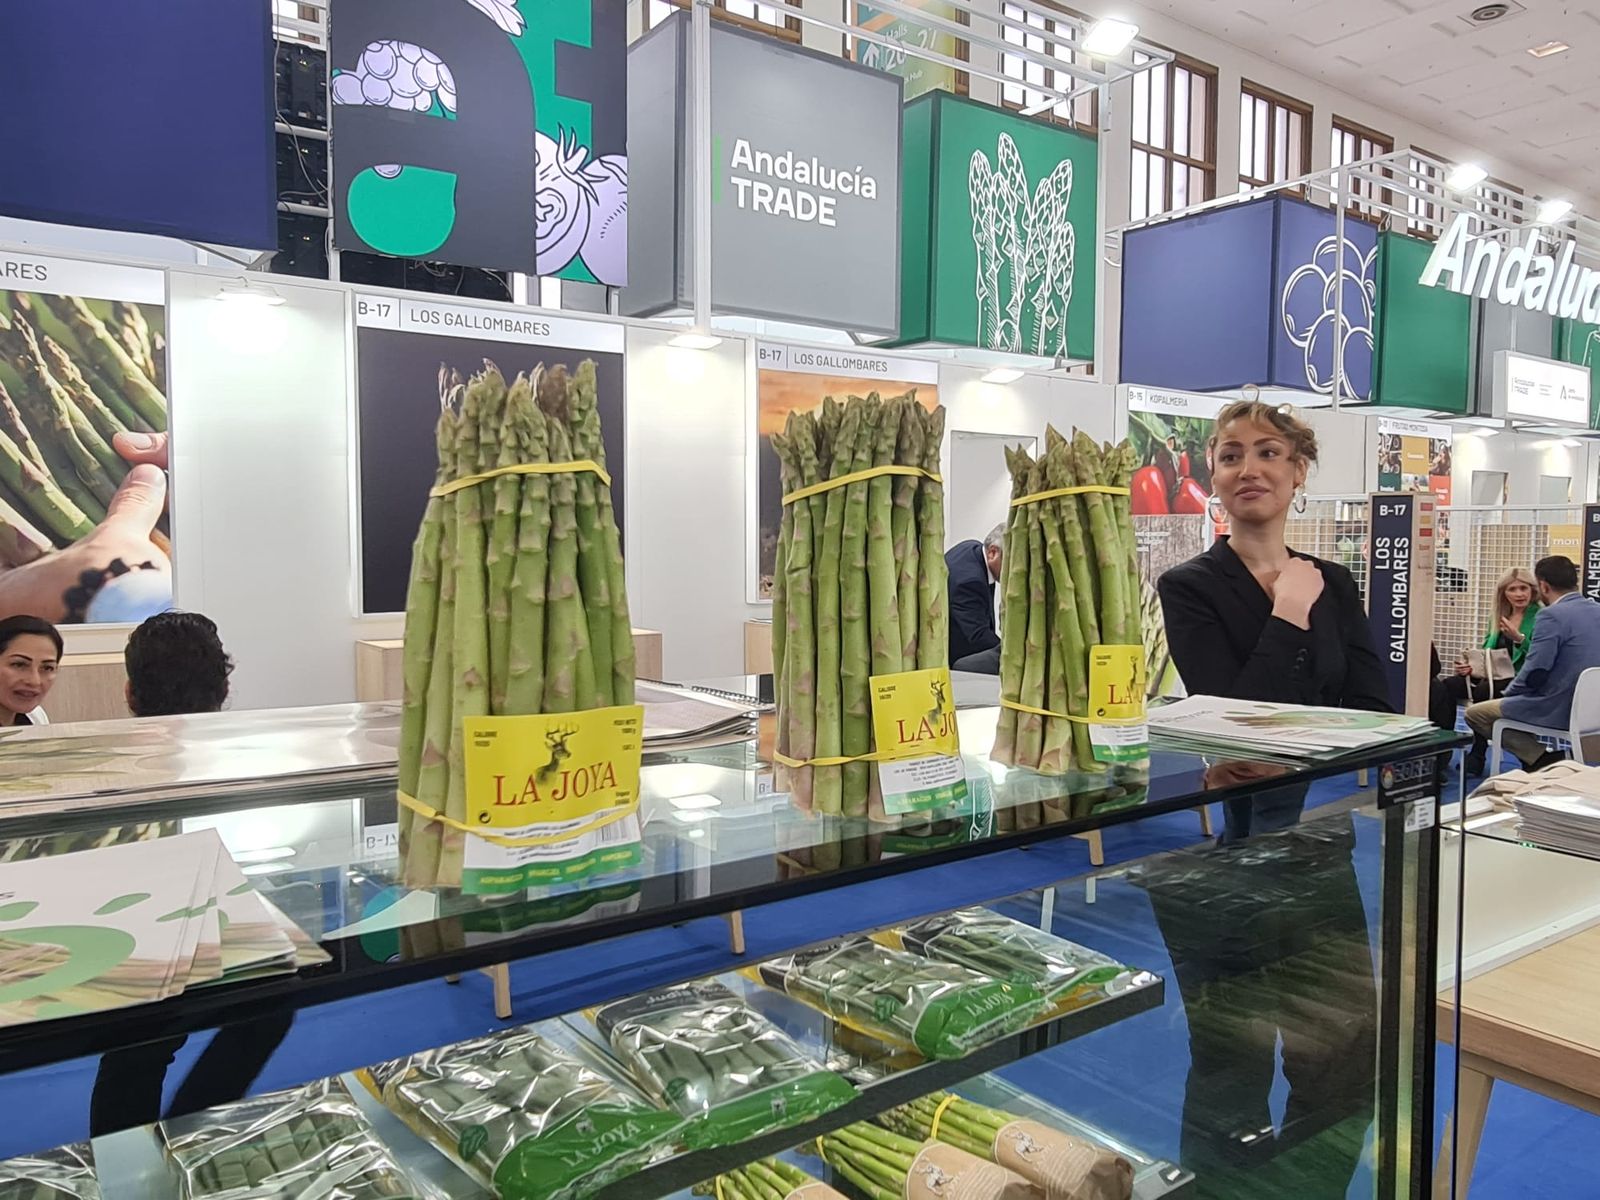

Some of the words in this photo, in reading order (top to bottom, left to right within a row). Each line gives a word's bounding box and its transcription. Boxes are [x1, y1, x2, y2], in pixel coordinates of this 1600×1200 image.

[731, 138, 877, 200] Andalucía
[730, 176, 837, 227] TRADE
[0, 261, 48, 281] RES
[357, 301, 391, 318] B-17
[410, 308, 440, 325] LOS
[444, 312, 551, 336] GALLOMBARES
[759, 348, 782, 361] B-17
[794, 352, 814, 366] LOS
[816, 354, 888, 373] GALLOMBARES
[1379, 504, 1406, 517] B-17
[1375, 537, 1390, 570] LOS
[1389, 537, 1409, 663] GALLOMBARES
[896, 716, 936, 745] LA
[493, 773, 541, 807] LA
[551, 761, 617, 801] JOYA
[984, 991, 1015, 1011] JOYA
[592, 1119, 640, 1155] JOYA
